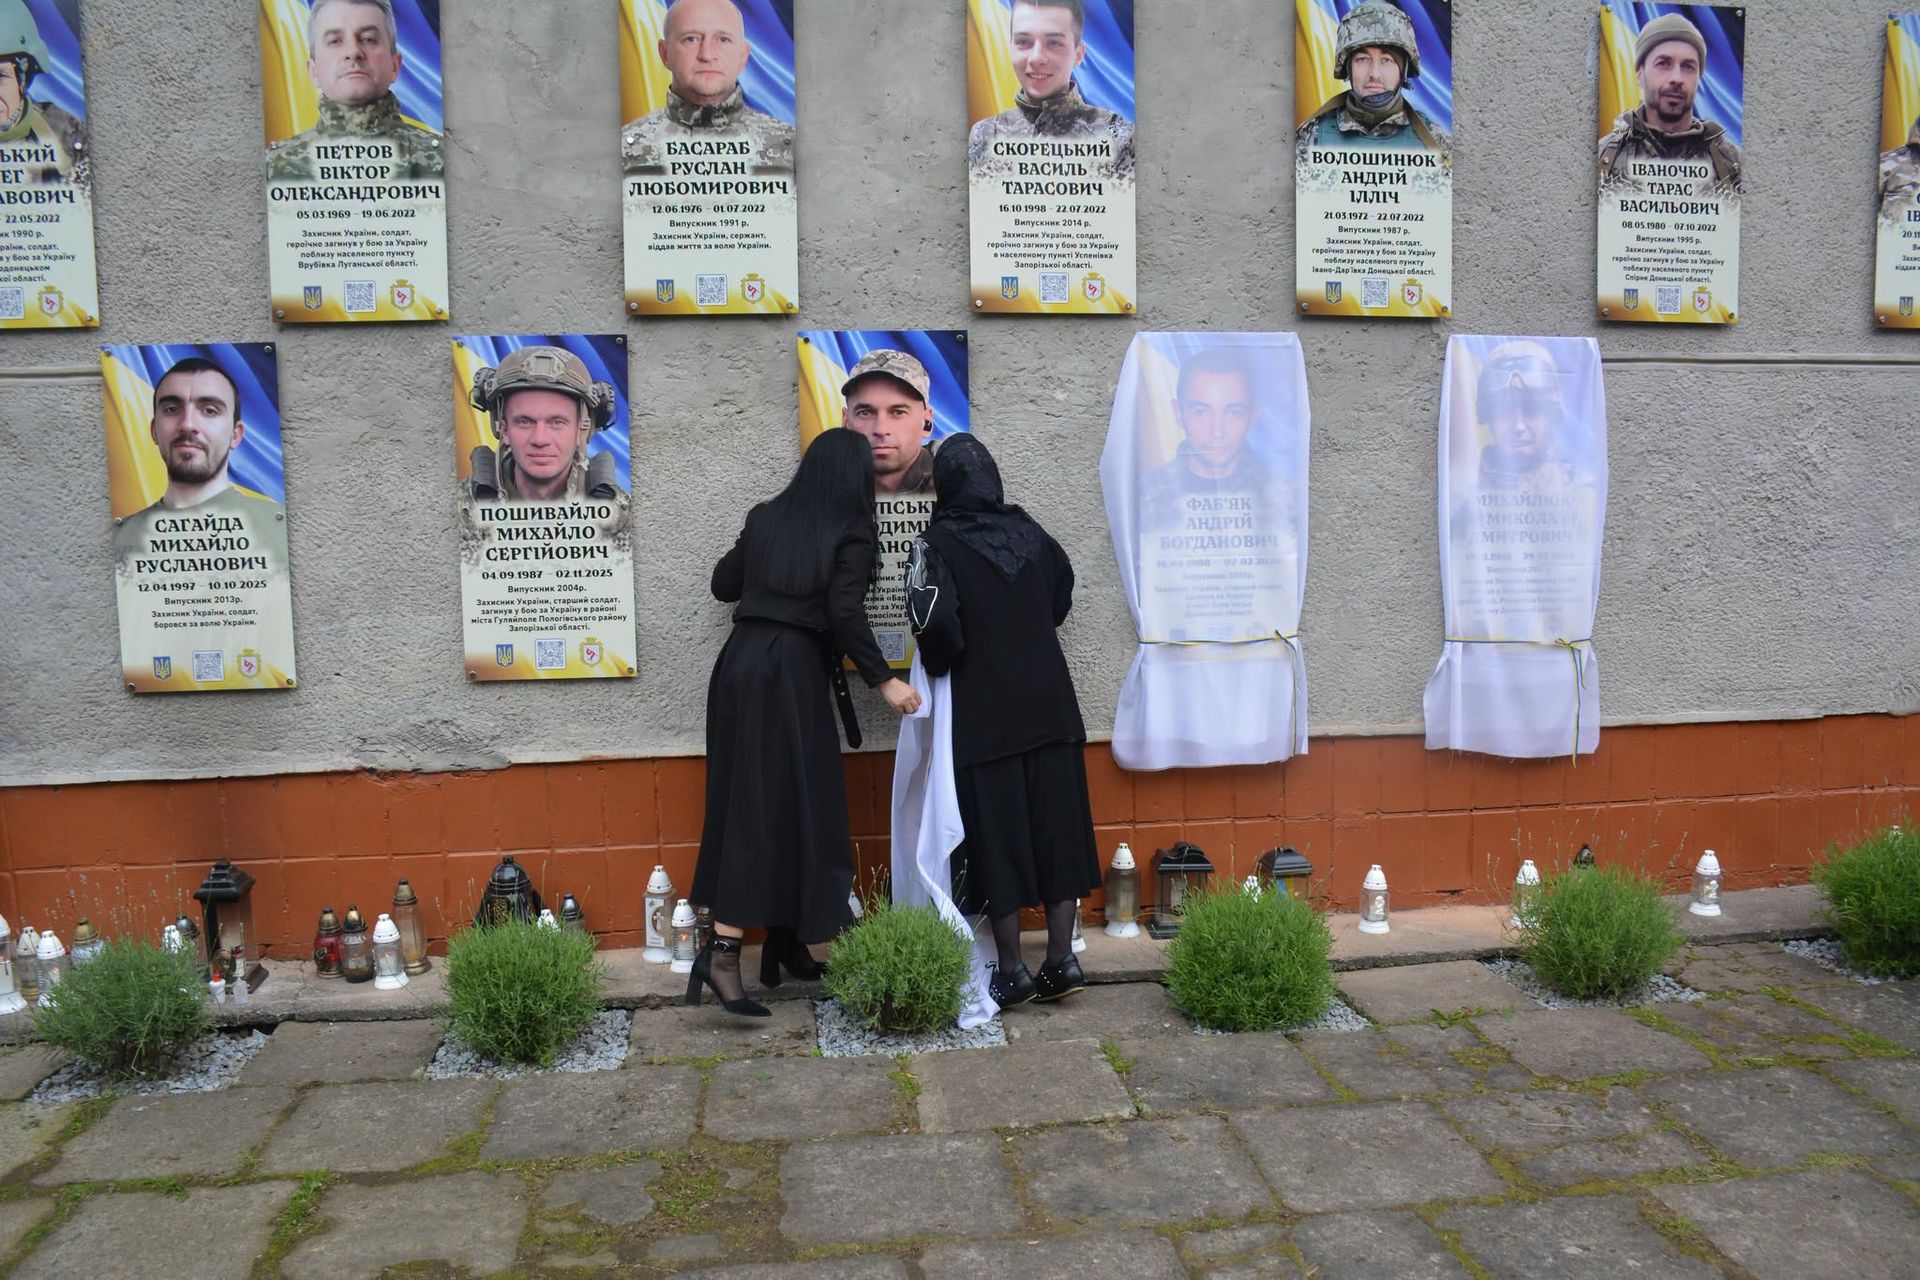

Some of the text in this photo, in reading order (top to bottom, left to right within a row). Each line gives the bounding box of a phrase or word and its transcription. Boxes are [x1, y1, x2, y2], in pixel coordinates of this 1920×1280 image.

[315, 145, 392, 159] ПЕТРОВ
[666, 141, 750, 156] БАСАРАБ
[994, 140, 1111, 159] СКОРЕЦЬКИЙ
[1312, 151, 1436, 167] ВОЛОШИНЮК
[319, 165, 390, 180] ВІКТОР
[671, 162, 746, 176] РУСЛАН
[1018, 162, 1087, 177] ВАСИЛЬ
[1632, 164, 1708, 178] ІВАНОЧКО
[1341, 169, 1407, 187] АНДРІЙ
[271, 185, 441, 203] ОЛЕКСАНДРОВИЧ
[629, 181, 788, 197] ЛЮБОМИРОВИЧ
[1002, 181, 1103, 196] ТАРАСОВИЧ
[1647, 182, 1693, 196] ТАРАС
[1350, 190, 1400, 204] ІЛЛІЧ
[297, 209, 415, 219] 05.03.1969 19.06.2022
[653, 204, 765, 214] 12.06.1976 01.07.2022
[999, 204, 1106, 213] 16.10.1998 22.07.2022
[1620, 200, 1720, 215] ВАСИЛЬОВИЧ
[6, 214, 60, 224] 22.05.2022
[1324, 212, 1424, 221] 21.03.1972 22.07.2022
[1622, 221, 1716, 232] 08.05.1980 07.10.2022
[480, 502, 611, 521] ПОШИВАЙЛО
[155, 513, 244, 533] САГАЙДА
[497, 523, 595, 541] МИХАЙЛО
[150, 534, 250, 552] МИХАЙЛО
[486, 542, 609, 562] СЕРГІЙОВИЧ
[136, 556, 268, 574] РУСЛАНОВИЧ
[482, 569, 613, 580] 04.09.1987 02.11.2025
[138, 580, 267, 592] 12.04.1997 10.10.2025
